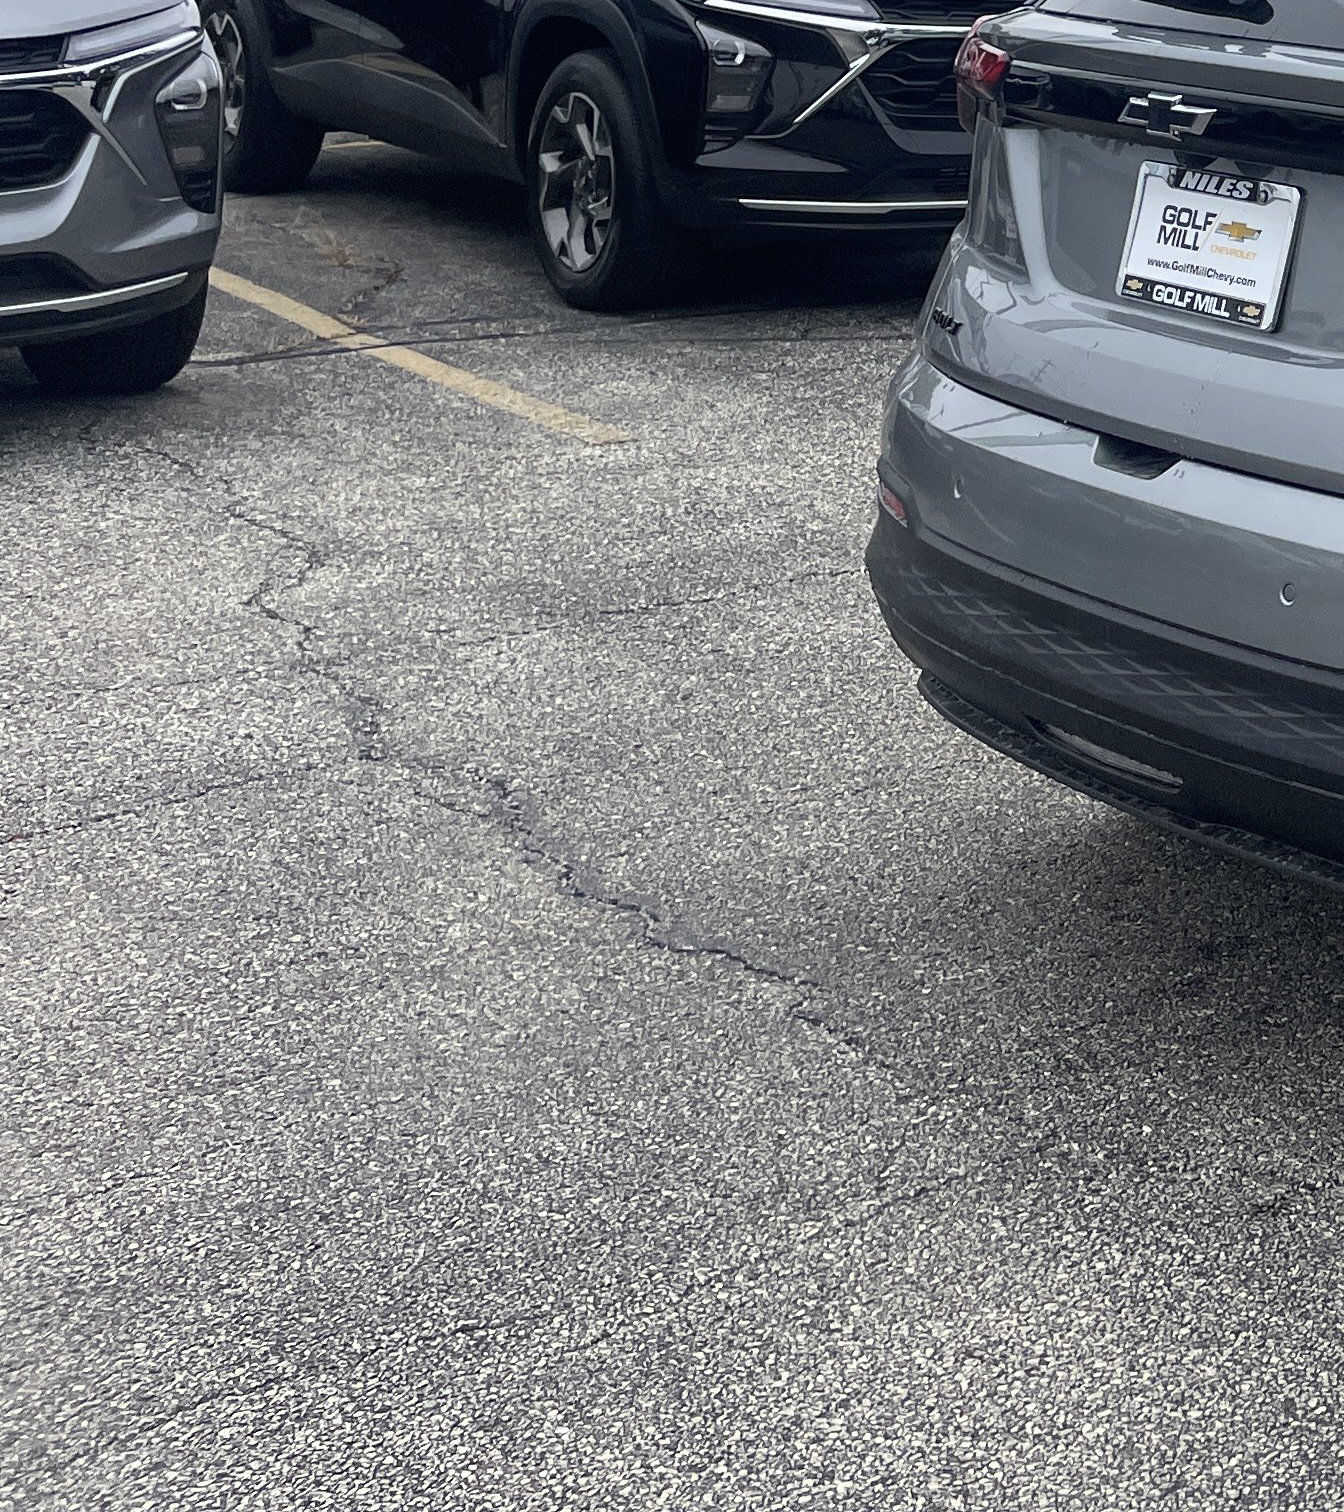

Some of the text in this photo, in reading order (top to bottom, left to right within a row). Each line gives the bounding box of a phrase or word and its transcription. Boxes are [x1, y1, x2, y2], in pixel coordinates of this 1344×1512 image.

[1179, 171, 1253, 200] NILES
[1161, 204, 1218, 232] GOLF
[1156, 224, 1201, 252] MILL
[1210, 245, 1256, 260] CHEVROLET
[1147, 256, 1257, 288] www.GolfMillChevy.com
[1152, 284, 1231, 318] GOLF MILL
